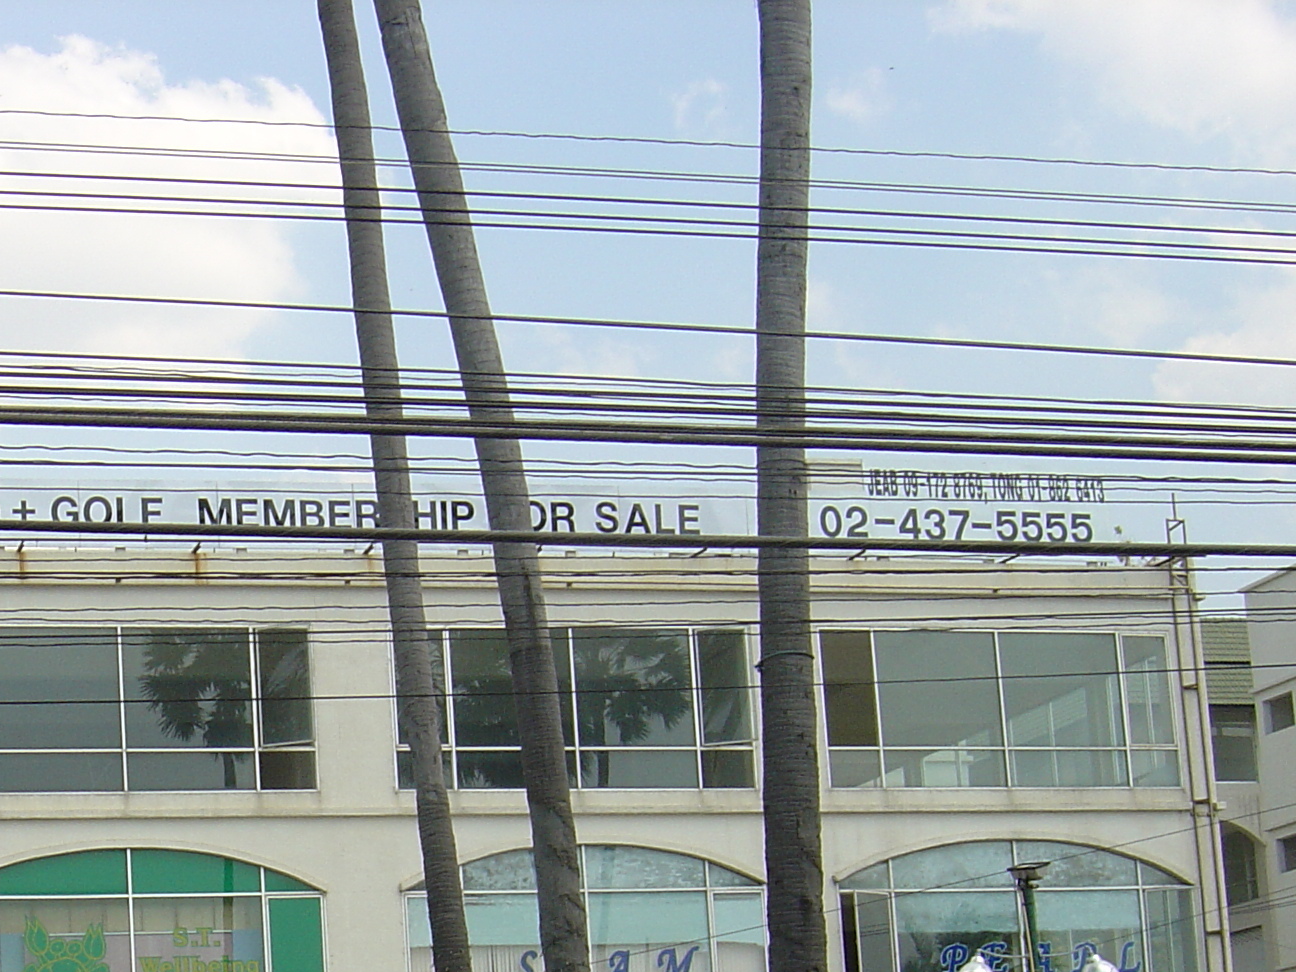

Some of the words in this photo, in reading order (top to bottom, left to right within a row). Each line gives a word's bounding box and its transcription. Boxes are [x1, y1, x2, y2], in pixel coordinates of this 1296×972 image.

[197, 497, 476, 532] MEMBERHIP
[594, 502, 701, 535] SALE
[819, 505, 1094, 543] 02-437-5555
